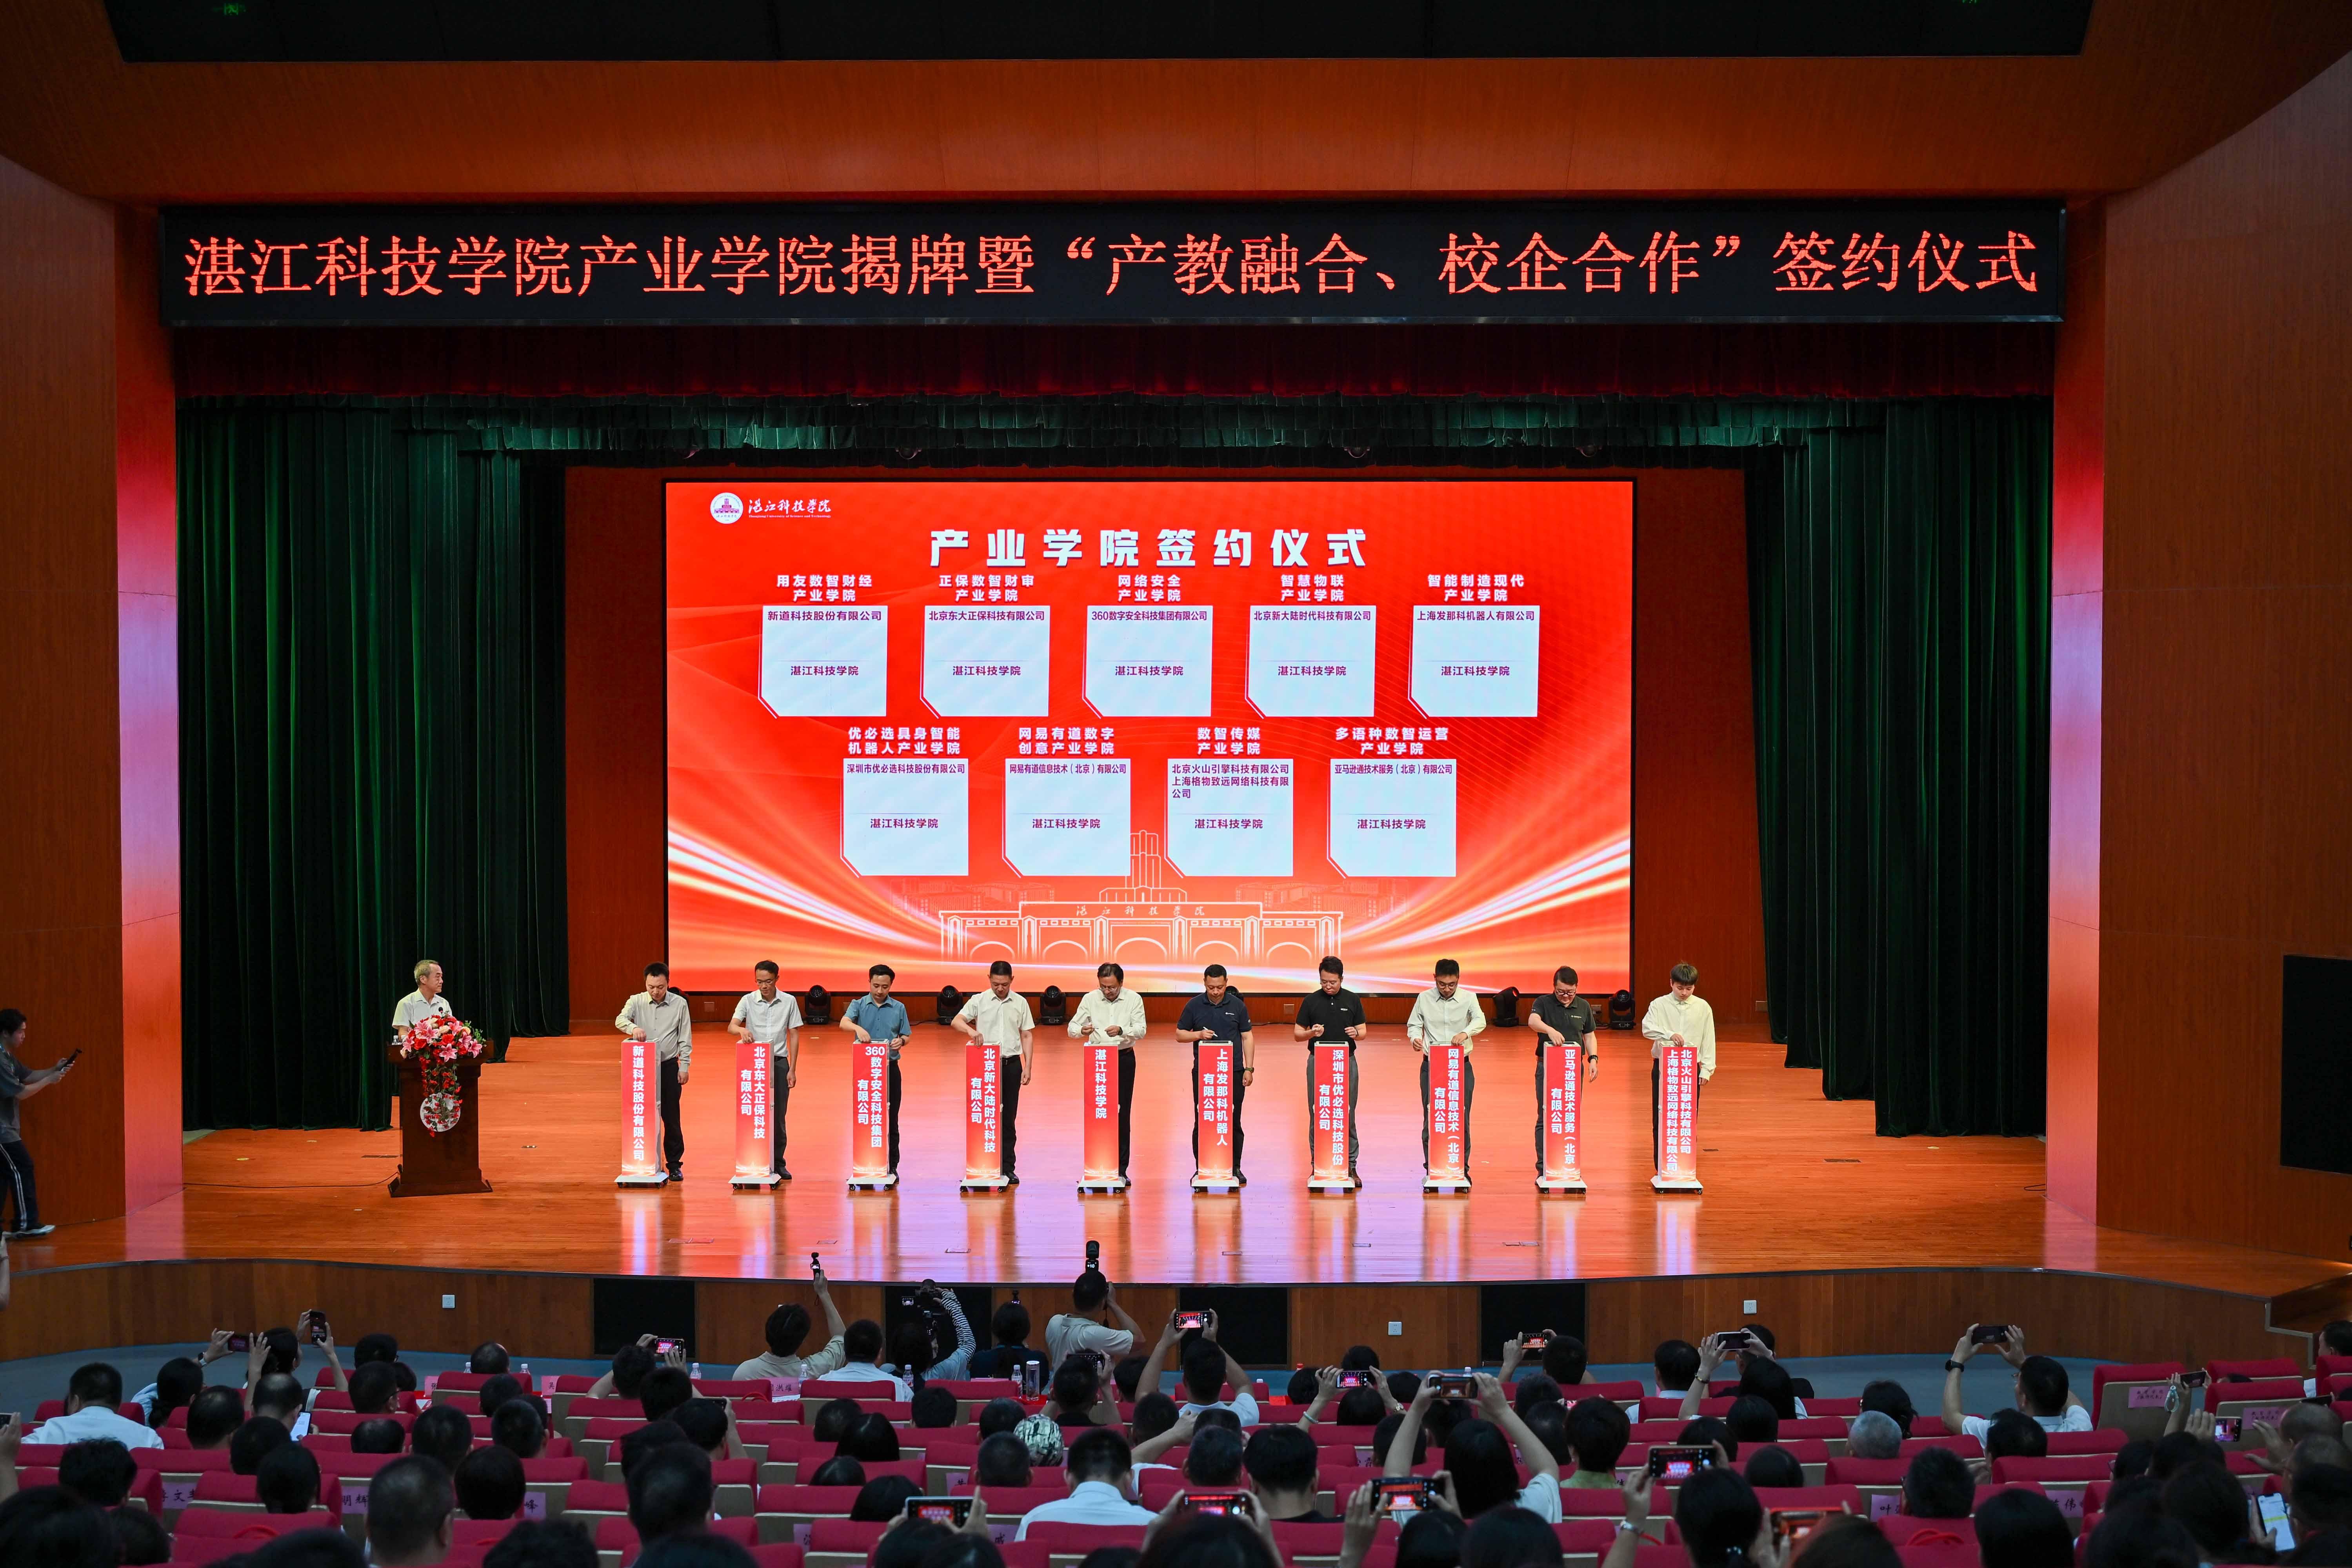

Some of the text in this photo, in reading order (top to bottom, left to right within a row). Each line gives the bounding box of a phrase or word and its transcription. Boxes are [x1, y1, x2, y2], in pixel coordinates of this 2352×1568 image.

[931, 529, 1365, 566] 产业学院签约仪式
[777, 575, 871, 587] 用友数智财经
[939, 575, 1034, 587] 正保数智财审
[1119, 575, 1180, 587] 网络安全
[1281, 575, 1343, 587] 智慧物联
[1428, 574, 1523, 587] 智能制造现代
[794, 589, 855, 601] 产业学院
[956, 589, 1017, 601] 产业学院
[1118, 589, 1180, 601] 产业学院
[1281, 589, 1343, 601] 产业学院
[1445, 589, 1507, 601] 产业学院
[768, 611, 881, 620] 新道科技股份有限公司
[929, 611, 1044, 620] 北京东大正保科技有限公司
[1092, 611, 1207, 620] 360数字安全科技集团有限公司
[1254, 611, 1370, 620] 北京新大陆时代科技有限公司
[1417, 611, 1534, 620] 上海发那科机器人有限公司
[791, 666, 858, 675] 湛江科技学院
[953, 666, 1020, 675] 湛江科技学院
[1116, 666, 1183, 676] 湛江科技学院
[1278, 666, 1346, 676] 湛江科技学院
[1441, 666, 1509, 676] 湛江科技学院
[849, 727, 960, 739] 优必选具身智能
[1020, 727, 1114, 739] 网易有道数字
[1198, 727, 1260, 739] 数智传媒
[1336, 727, 1448, 740] 多语种数智运营
[849, 742, 960, 754] 机器人产业学院
[1019, 742, 1114, 754] 创意产业学院
[1198, 742, 1260, 754] 产业学院
[1361, 743, 1423, 754] 产业学院
[847, 764, 964, 773] 深圳市优必选科技股份有限公司
[1172, 764, 1289, 774] 北京火山引擎科技有限公司
[1172, 776, 1289, 786] 上海格物致远网络科技有限
[1172, 789, 1190, 798] 公司
[871, 819, 938, 828] 湛江科技学院
[1033, 819, 1100, 828] 湛江科技学院
[1195, 819, 1263, 829] 湛江科技学院
[1358, 819, 1425, 829] 湛江科技学院
[1096, 1049, 1107, 1118] 湛江科技学院
[741, 1070, 752, 1115] 有限公司
[754, 1047, 765, 1139] 北京东大正保科技
[1204, 1074, 1214, 1121] 有限公司
[1217, 1049, 1228, 1145] 上海发那科机器人
[633, 1046, 644, 1161] 新道科技股份有限公司
[858, 1079, 869, 1124] 有限公司
[971, 1077, 982, 1123] 有限公司
[984, 1048, 995, 1152] 北京新大陆时代科技
[1680, 1050, 1692, 1154] 北京火山引擎科技有限公司
[1320, 1085, 1330, 1130] 有限公司
[1332, 1050, 1344, 1165] 深圳市优必选科技股份
[1435, 1087, 1445, 1133] 有限公司
[1551, 1088, 1562, 1134] 有限公司
[1667, 1049, 1678, 1171] 上海格物致远网络科技有限公司
[771, 1383, 792, 1392] 洪耀
